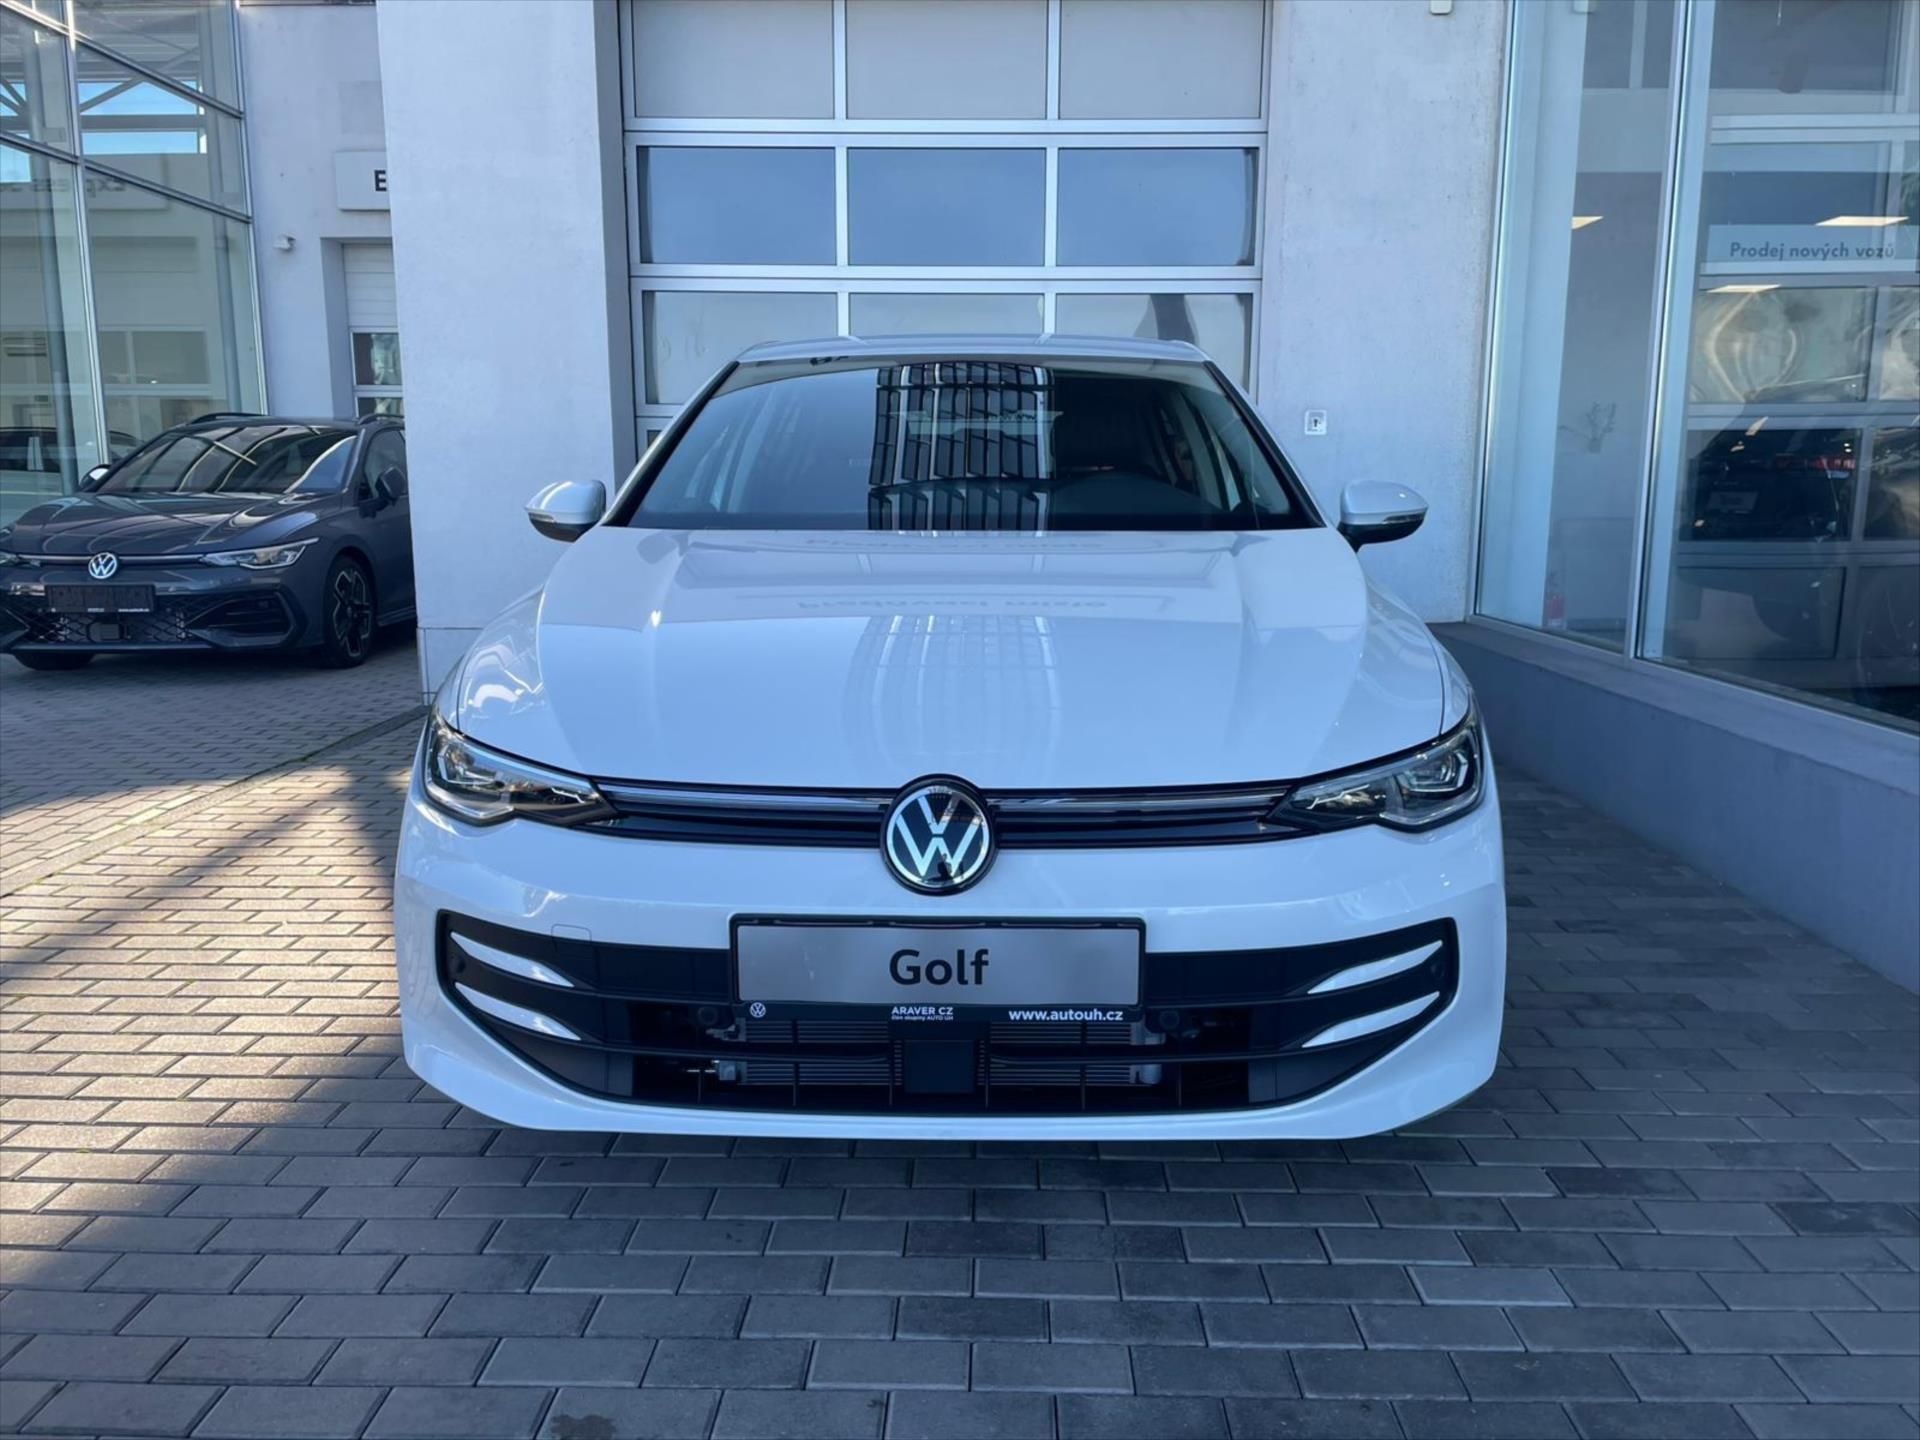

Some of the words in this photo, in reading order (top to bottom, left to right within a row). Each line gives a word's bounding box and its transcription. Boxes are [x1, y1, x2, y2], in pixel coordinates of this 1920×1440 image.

[1730, 241, 1784, 260] Prodej
[1789, 243, 1849, 261] nových
[1855, 243, 1895, 259] vozů
[889, 948, 990, 986] Golf
[891, 1006, 936, 1015] ARAVER
[938, 1006, 954, 1015] CZ
[1008, 1008, 1124, 1021] www.autouh.cz
